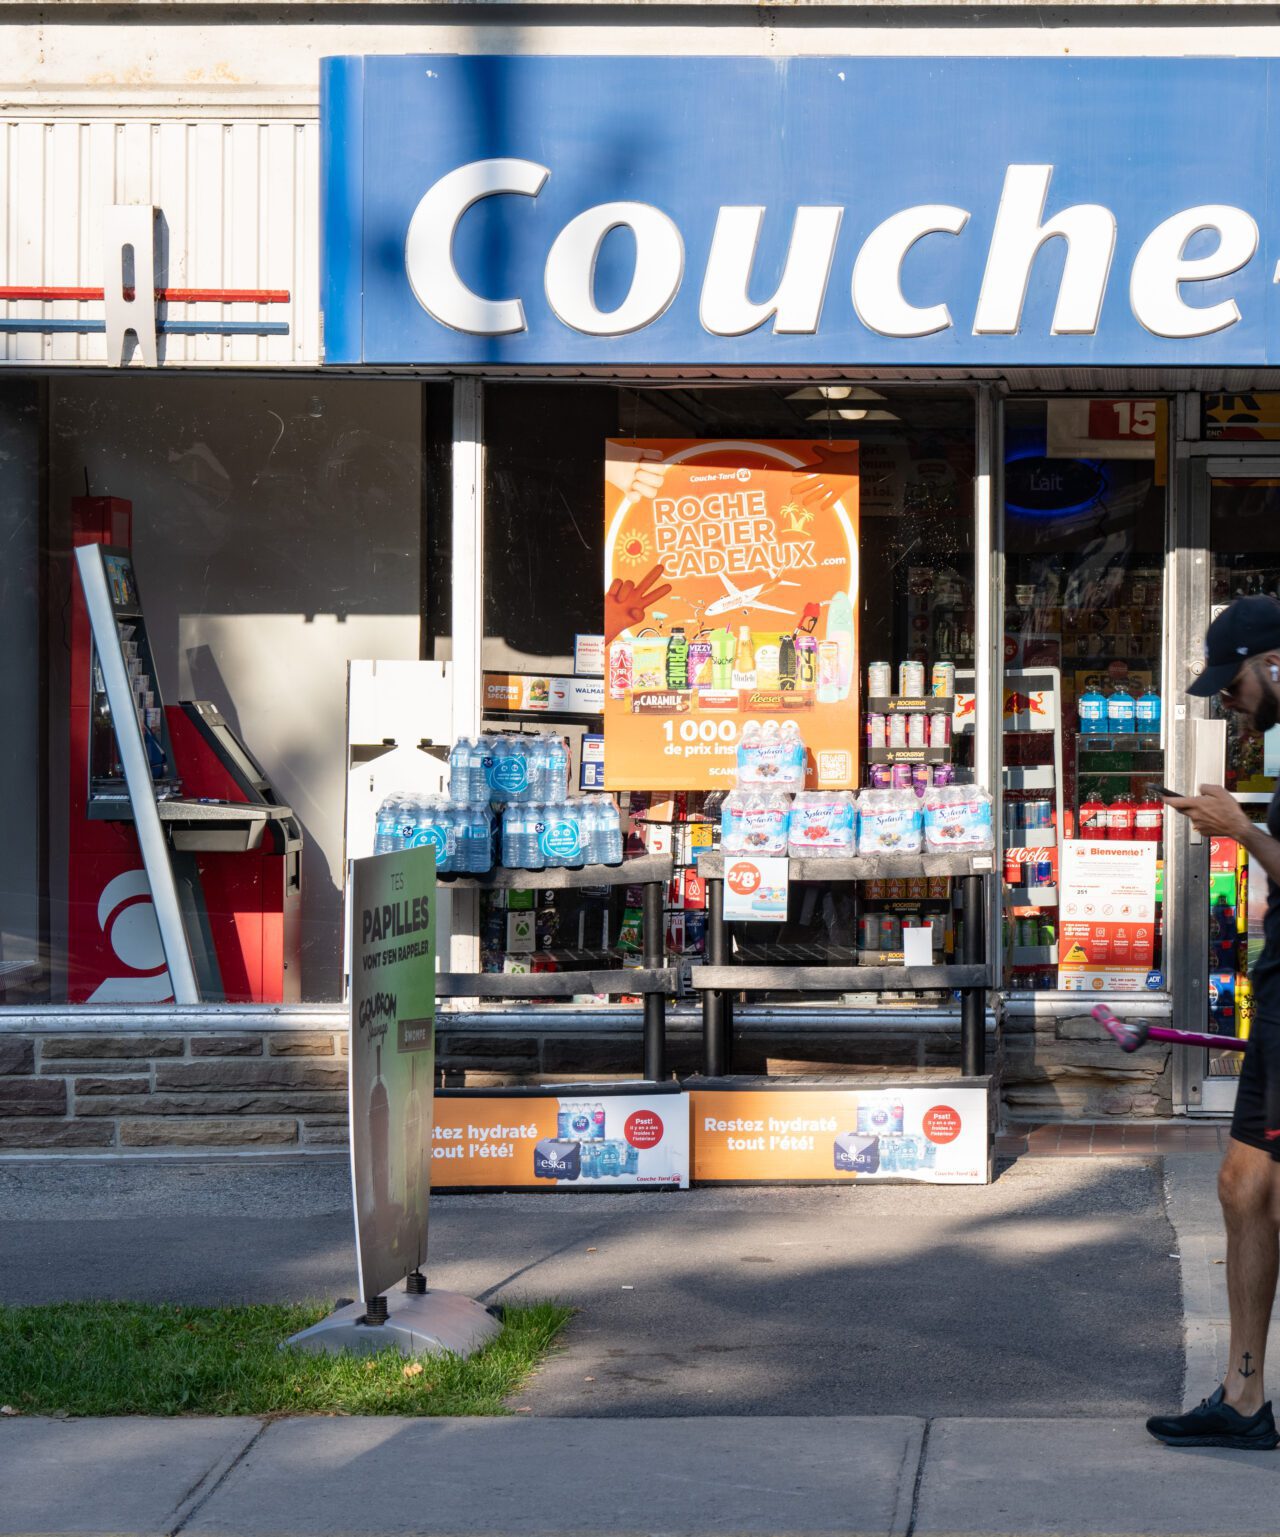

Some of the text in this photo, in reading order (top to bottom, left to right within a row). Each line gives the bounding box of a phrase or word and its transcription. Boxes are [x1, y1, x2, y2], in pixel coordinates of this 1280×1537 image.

[1030, 473, 1064, 491] Lait
[654, 490, 766, 524] ROCHE
[654, 518, 777, 552] PAPIER
[656, 541, 847, 580] CADEAUX .com
[689, 643, 712, 653] VIZZY
[669, 645, 686, 686] PRIME
[640, 695, 682, 706] CARAMILK
[663, 743, 682, 756] de
[684, 743, 711, 758] prix
[803, 808, 833, 819] Splash
[390, 872, 405, 891] TES
[362, 895, 430, 945] PAPILLES
[362, 953, 381, 972] VONT
[398, 939, 430, 962] RAPPELER
[468, 1123, 538, 1143] hydraté
[704, 1115, 838, 1136] Restez hydraté
[727, 1136, 765, 1151] tout
[541, 1160, 566, 1169] eska
